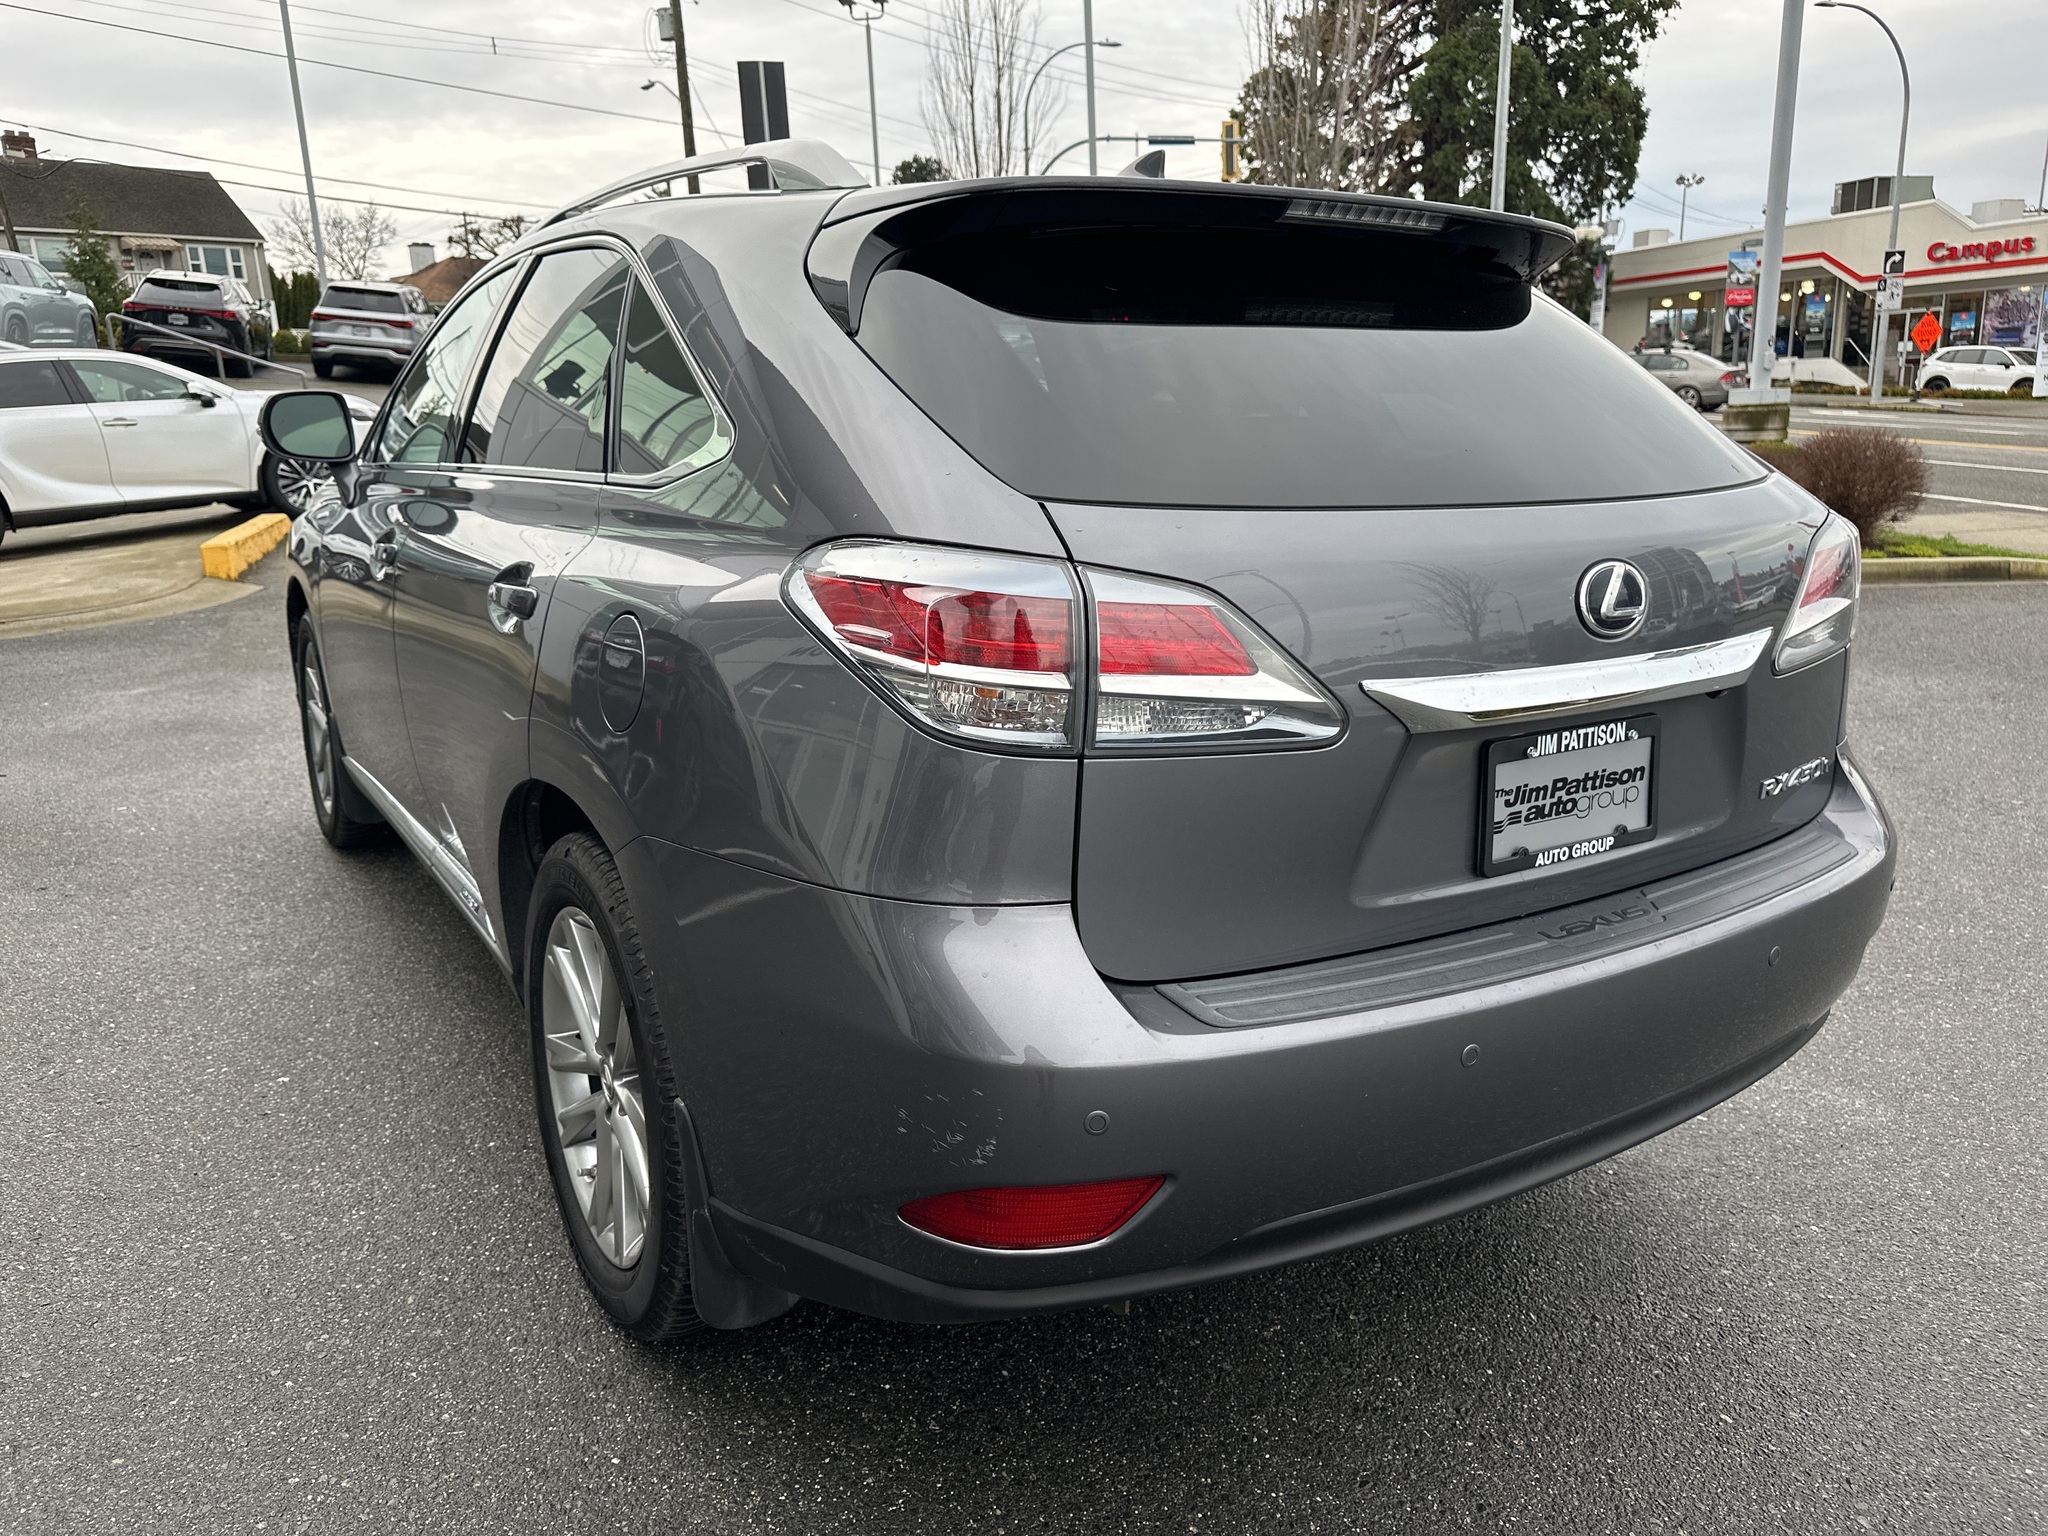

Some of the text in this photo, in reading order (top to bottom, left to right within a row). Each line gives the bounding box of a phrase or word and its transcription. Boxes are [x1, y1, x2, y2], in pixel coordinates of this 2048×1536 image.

[1926, 236, 2034, 263] Campus
[1533, 721, 1626, 757] JIM PATTISON
[1495, 765, 1646, 808] The Jim Pattison
[1535, 836, 1615, 867] AUTO GROUP
[1537, 904, 1651, 940] LEXUS
